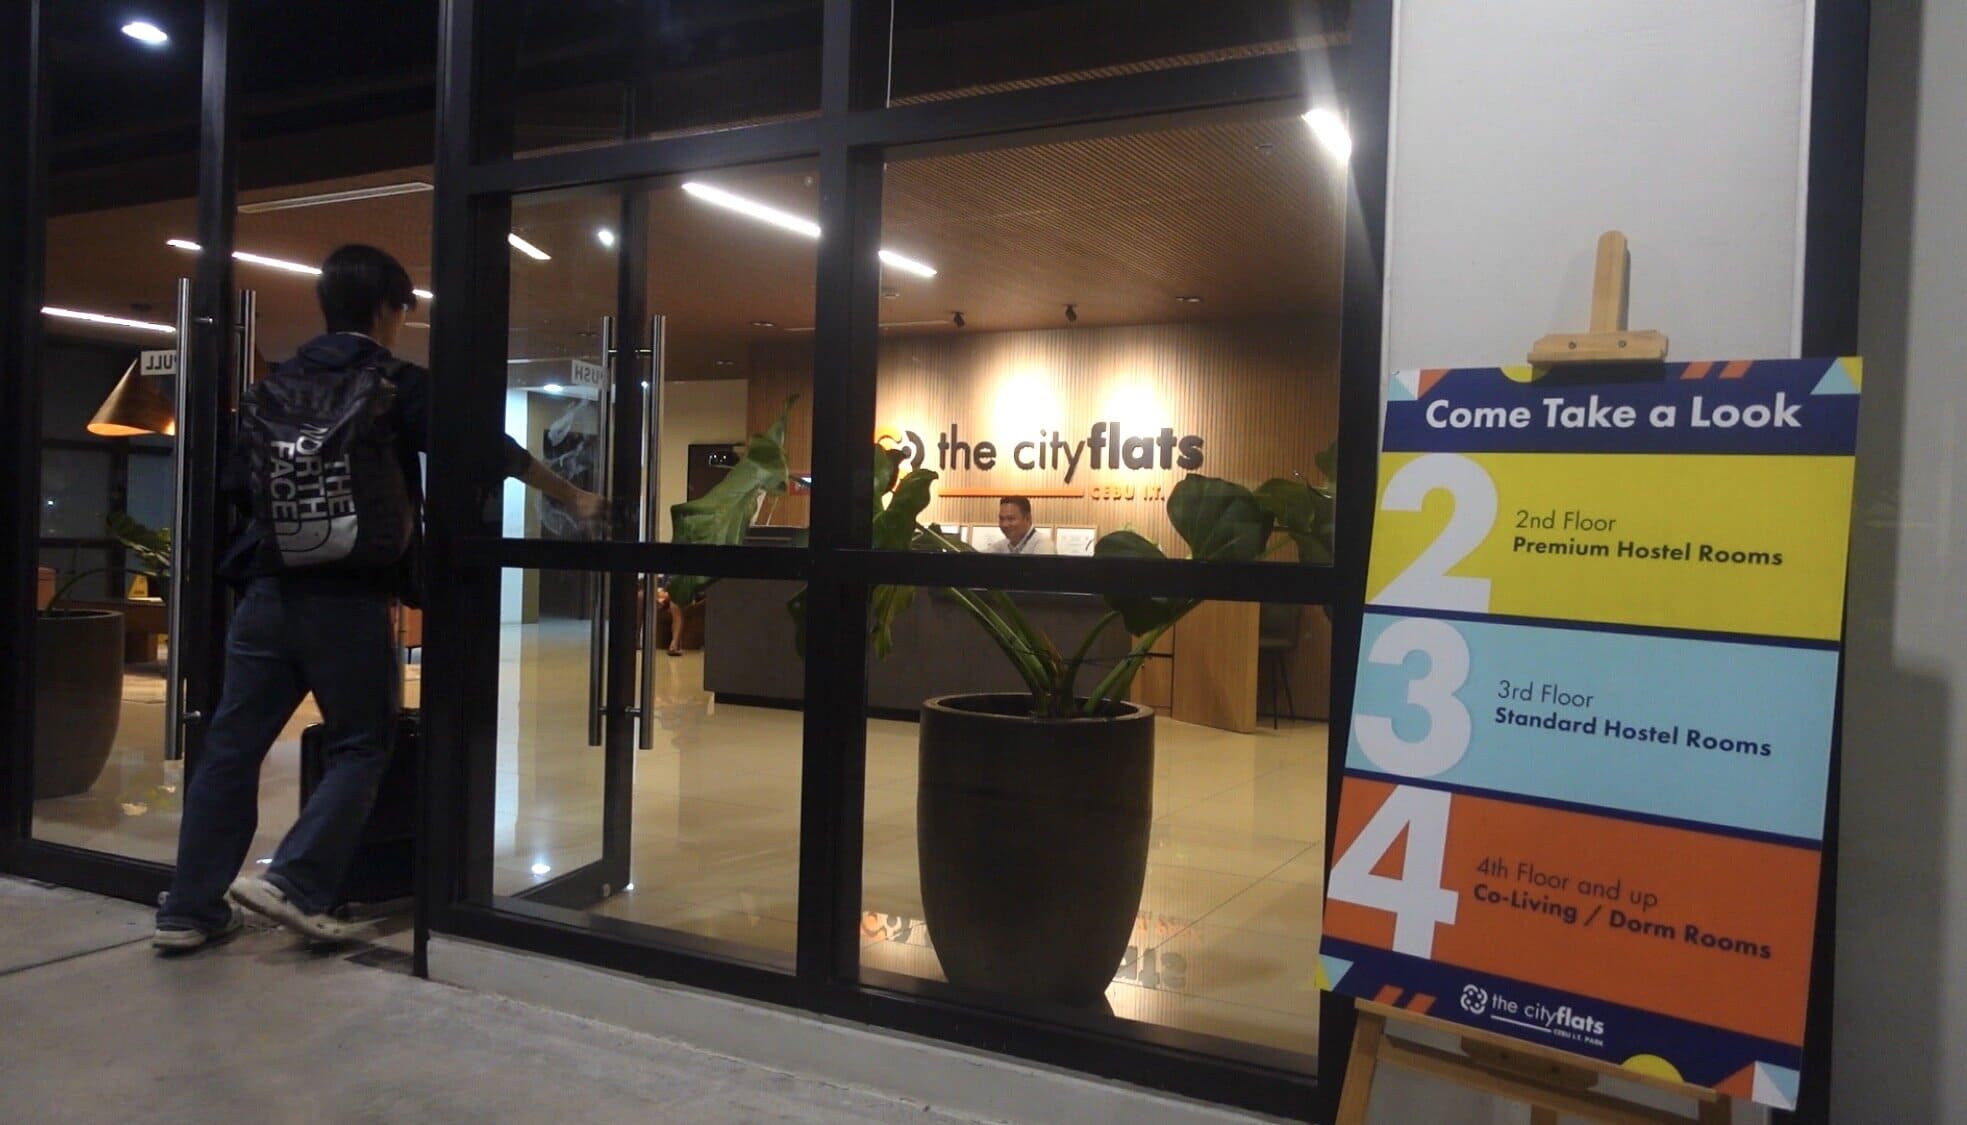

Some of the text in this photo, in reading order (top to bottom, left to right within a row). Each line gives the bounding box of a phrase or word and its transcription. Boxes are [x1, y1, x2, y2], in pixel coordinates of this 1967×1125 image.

[1426, 392, 1802, 429] Come Take a Look
[270, 440, 299, 520] FACE
[295, 423, 329, 520] NORTH
[938, 421, 1205, 485] the cityflats
[324, 453, 356, 516] THE
[1091, 486, 1135, 501] CEBU
[1366, 452, 1499, 614] 2
[1515, 509, 1617, 532] 2nd Floor
[1512, 535, 1783, 566] Premium Hostel Rooms
[1354, 616, 1472, 778] 3
[1497, 679, 1594, 708] 3rd Floor
[1495, 706, 1772, 757] Standard Hostel Rooms
[1327, 783, 1459, 960] 4
[1476, 856, 1658, 912] 4th Floor and up
[1474, 883, 1772, 960] Co-Living / Dorm Rooms
[1491, 993, 1605, 1036] the cityflats
